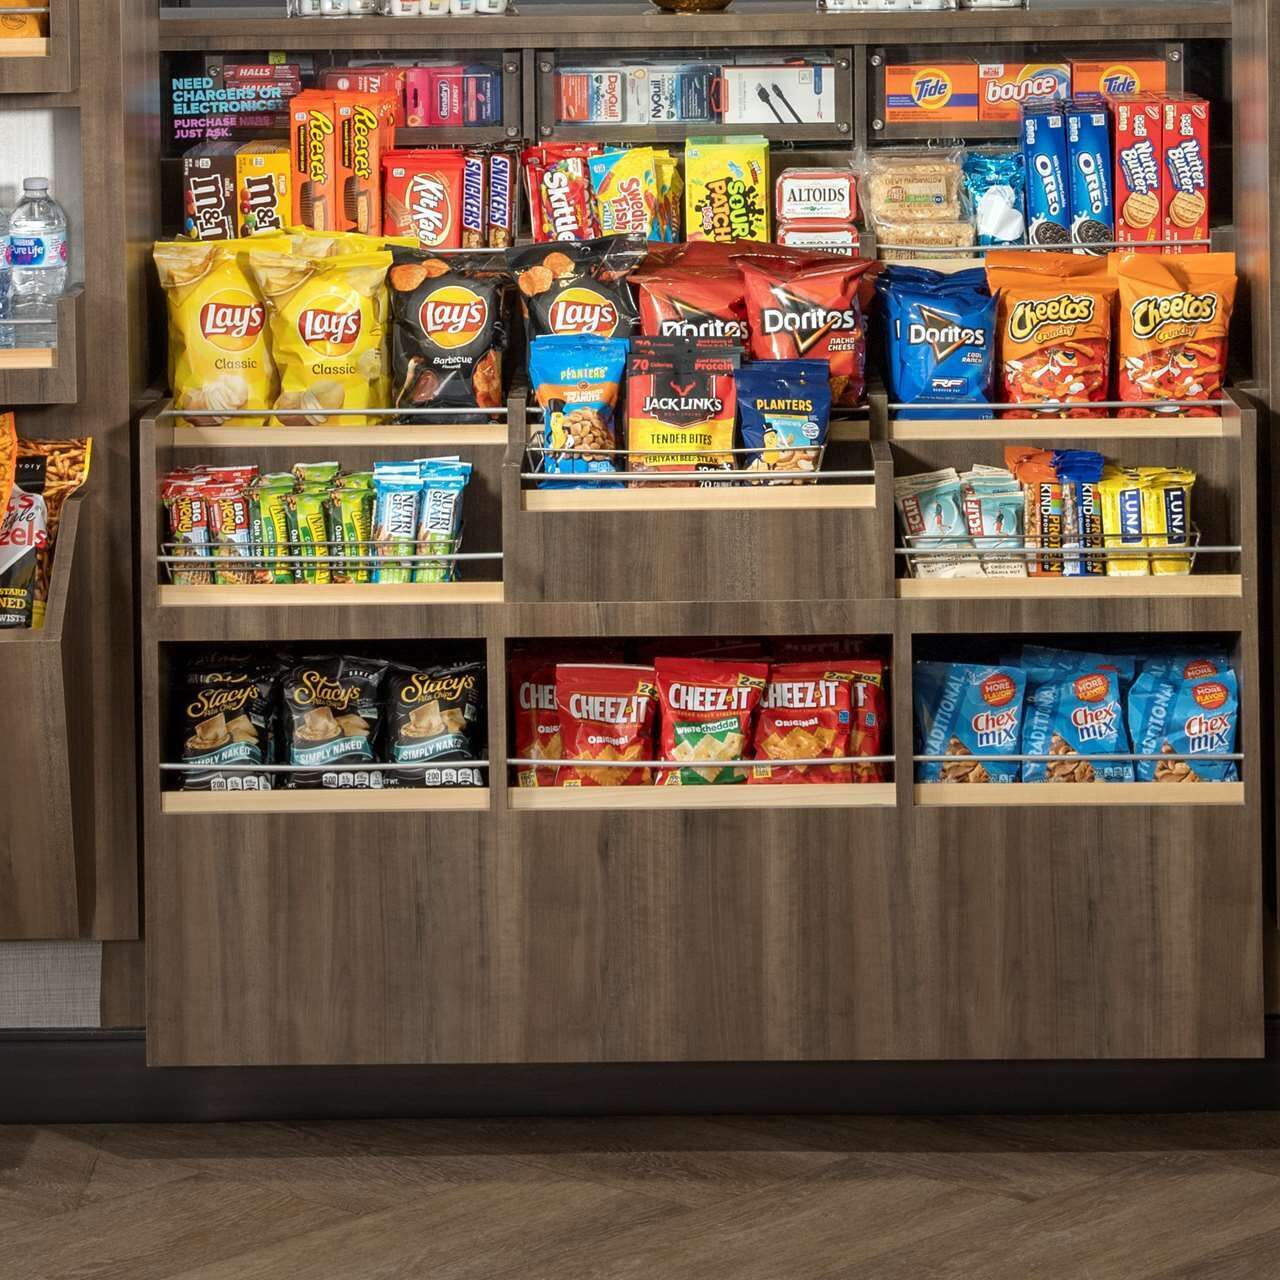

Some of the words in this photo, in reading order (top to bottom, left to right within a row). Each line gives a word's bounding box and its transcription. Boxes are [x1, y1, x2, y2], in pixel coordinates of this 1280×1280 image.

[172, 77, 213, 90] NEED
[239, 68, 271, 77] HALLS
[1102, 75, 1136, 93] Tide
[172, 87, 256, 102] CHARGERS
[259, 87, 282, 98] OR
[439, 82, 450, 117] Benadryl
[608, 74, 619, 119] DayQuil
[651, 79, 662, 120] NyQuil
[914, 78, 948, 99] Tide
[986, 75, 1057, 104] bounce
[174, 117, 237, 128] PURCHASE
[174, 128, 202, 139] JUST
[205, 127, 233, 137] ASK.
[308, 110, 334, 184] Reese's
[353, 105, 378, 180] Reese's
[1121, 148, 1150, 195] Butter
[1134, 139, 1159, 189] Nutter
[1167, 146, 1196, 194] Butter
[1180, 139, 1206, 188] Nutter
[463, 157, 483, 231] SNICKERS
[490, 156, 510, 228] SNICKERS
[787, 187, 846, 203] ALTOIDS
[1033, 152, 1060, 217] OREO
[1077, 151, 1102, 215] OREO
[612, 196, 629, 231] Fish
[707, 180, 731, 242] PATCH
[727, 180, 750, 238] SOUR
[27, 244, 45, 257] Life
[204, 303, 265, 336] Lay's
[304, 308, 361, 344] Lay's
[425, 300, 484, 333] Lay's
[554, 301, 614, 333] Lay's
[764, 308, 855, 334] Doritos
[1010, 295, 1094, 340] Cheetos
[1132, 293, 1217, 339] Cheetos
[827, 343, 855, 351] CHEESE
[909, 325, 985, 346] Doritos
[1033, 326, 1076, 345] Crunchy
[1156, 325, 1198, 345] Crunchy
[214, 358, 258, 370] Classic
[312, 363, 356, 376] Classic
[432, 355, 473, 366] Barbecue
[632, 359, 650, 370] 70
[694, 363, 734, 371] Protein
[643, 396, 680, 412] JACK
[680, 397, 723, 412] LINK'S
[756, 399, 813, 412] PLANTERS
[650, 434, 687, 446] TENDER
[689, 434, 713, 446] BITES
[192, 500, 201, 522] BIG
[431, 490, 443, 533] GRAIN
[1040, 483, 1051, 515] KIND
[1081, 483, 1093, 515] KIND
[234, 502, 244, 524] BIG
[392, 493, 403, 534] GRAIN
[400, 494, 414, 538] NUTRI
[439, 492, 455, 534] NUTRI
[1124, 490, 1139, 542] LUNA
[1169, 490, 1184, 542] LUNA
[294, 670, 362, 711] Stacy's
[401, 673, 477, 703] Stacy's
[984, 682, 1010, 694] MORE
[984, 691, 1013, 702] FLAVOR
[1078, 678, 1103, 691] MORE
[1079, 686, 1107, 700] FLAVOR
[1196, 685, 1223, 696] MORE
[187, 683, 261, 719] Stacy's
[972, 707, 1017, 731] Chex
[1072, 703, 1115, 729] Chex
[1185, 712, 1231, 738] Chex
[978, 725, 1018, 749] mix
[1078, 720, 1116, 742] mix
[1189, 730, 1228, 754] mix
[220, 747, 252, 762] NAKED
[299, 749, 332, 764] SIMPLY
[332, 741, 363, 757] NAKED
[402, 745, 434, 761] SIMPLY
[435, 739, 463, 752] NAKED
[426, 771, 440, 782] 200
